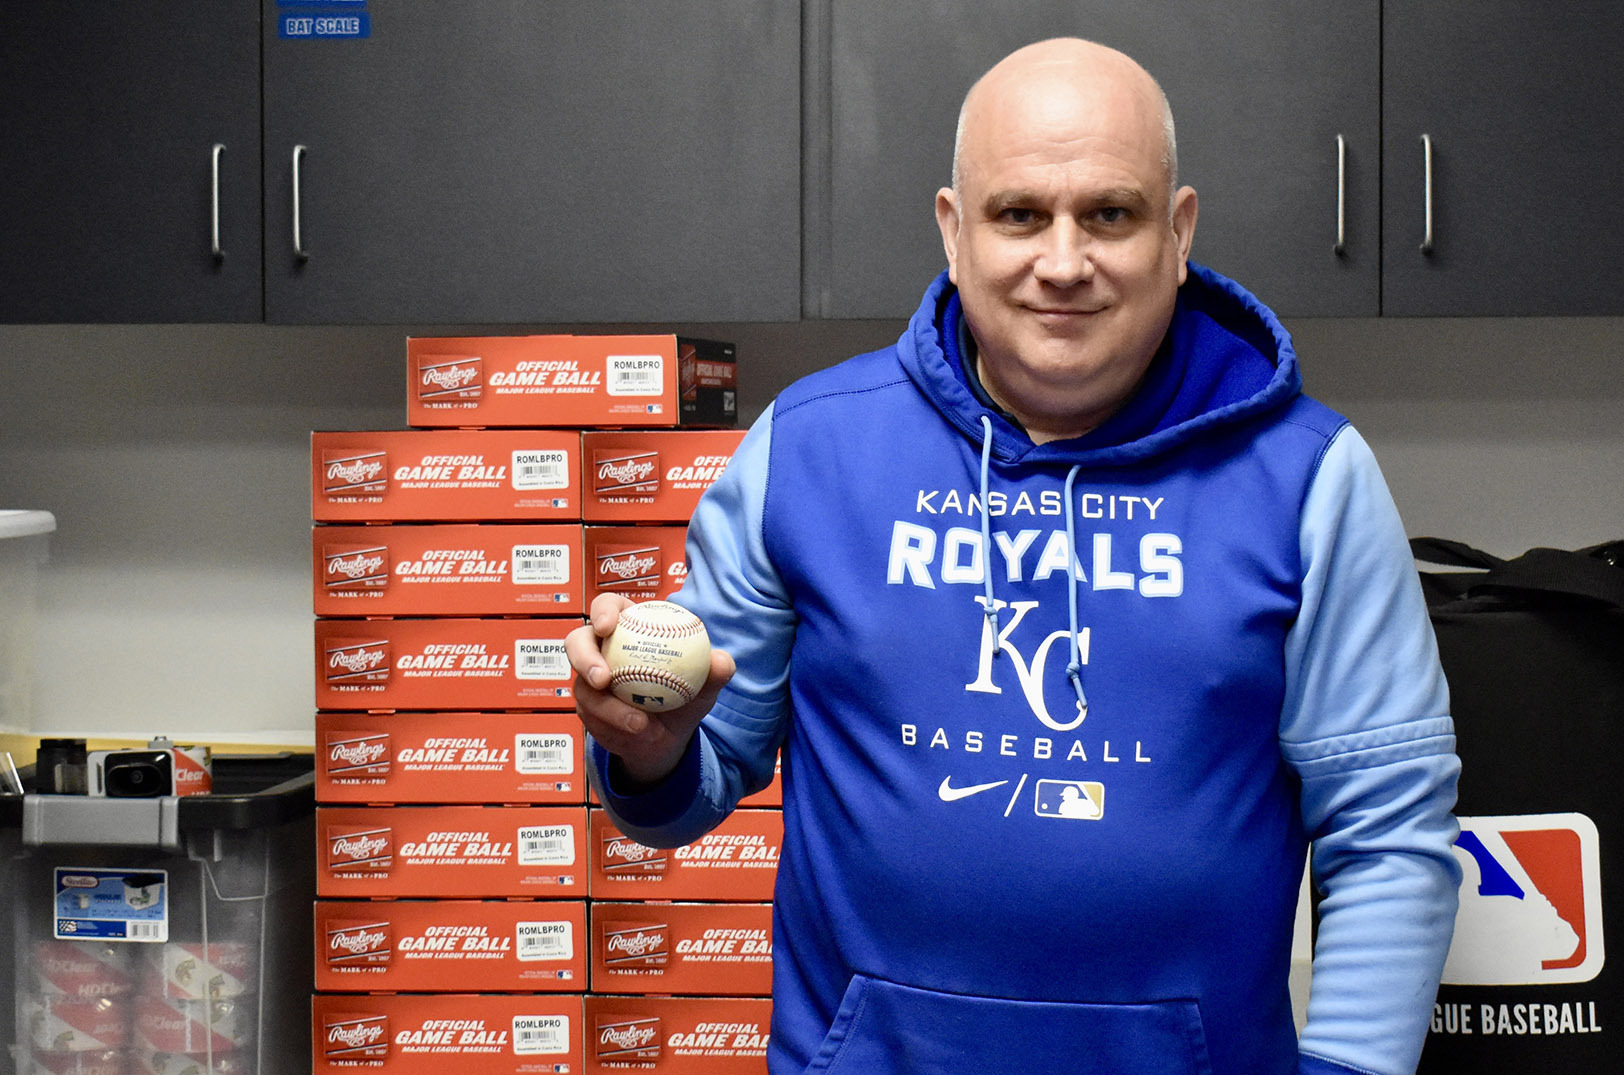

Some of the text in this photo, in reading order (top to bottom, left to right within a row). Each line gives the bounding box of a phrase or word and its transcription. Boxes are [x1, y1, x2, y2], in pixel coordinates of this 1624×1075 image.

[286, 18, 360, 35] BAT SCALE
[516, 361, 578, 371] OFFICIAL
[615, 360, 660, 369] ROMLBPRO
[422, 366, 478, 386] Rawlings
[489, 372, 600, 386] GAME BALL
[421, 456, 484, 466] OFFICIAL
[517, 454, 562, 463] ROMLBPRO
[328, 460, 382, 480] Rawlings
[394, 466, 506, 480] GAME BALL
[599, 460, 654, 480] Rawlings
[916, 489, 1164, 520] KANSAS CITY
[422, 550, 484, 560] OFFICIAL
[516, 550, 562, 558] ROMLBPRO
[886, 520, 1184, 598] ROYALS
[328, 555, 383, 575] Rawlings
[395, 561, 508, 576] GAME BALL
[600, 555, 656, 575] Rawlings
[424, 644, 486, 654] OFFICIAL
[520, 645, 566, 653] ROMLBPRO
[622, 644, 639, 652] MAJOR
[639, 646, 657, 654] LEAGUE
[658, 649, 683, 658] BASEBALL
[330, 648, 386, 669] Rawlings
[397, 655, 510, 670] GAME BALL
[965, 595, 1091, 732] KC
[424, 738, 486, 748] OFFICIAL
[521, 740, 566, 748] ROMLBPRO
[901, 723, 1152, 763] BASEBALL
[330, 742, 386, 762] Rawlings
[397, 749, 510, 764] GAME BALL
[426, 832, 489, 842] OFFICIAL
[521, 830, 567, 838] ROMLBPRO
[702, 835, 765, 845] OFFICIAL
[332, 836, 388, 856] Rawlings
[399, 842, 513, 857] GAME BALL
[674, 845, 780, 860] GAME BAL
[425, 926, 488, 936] OFFICIAL
[519, 926, 565, 934] ROMLBPRO
[703, 929, 767, 939] OFFICIAL
[331, 930, 386, 950] Rawlings
[398, 937, 510, 952] GAME BALL
[608, 932, 663, 952] Rawlings
[675, 939, 773, 954] GAME BA
[422, 1020, 484, 1030] OFFICIAL
[515, 1020, 561, 1028] ROMLBPRO
[1481, 1002, 1602, 1036] BASEBALL
[328, 1024, 383, 1044] Rawlings
[601, 1025, 656, 1045] Rawlings
[695, 1023, 759, 1033] OFFICIAL
[395, 1031, 508, 1046] GAME BALL
[667, 1033, 730, 1048] GAME
